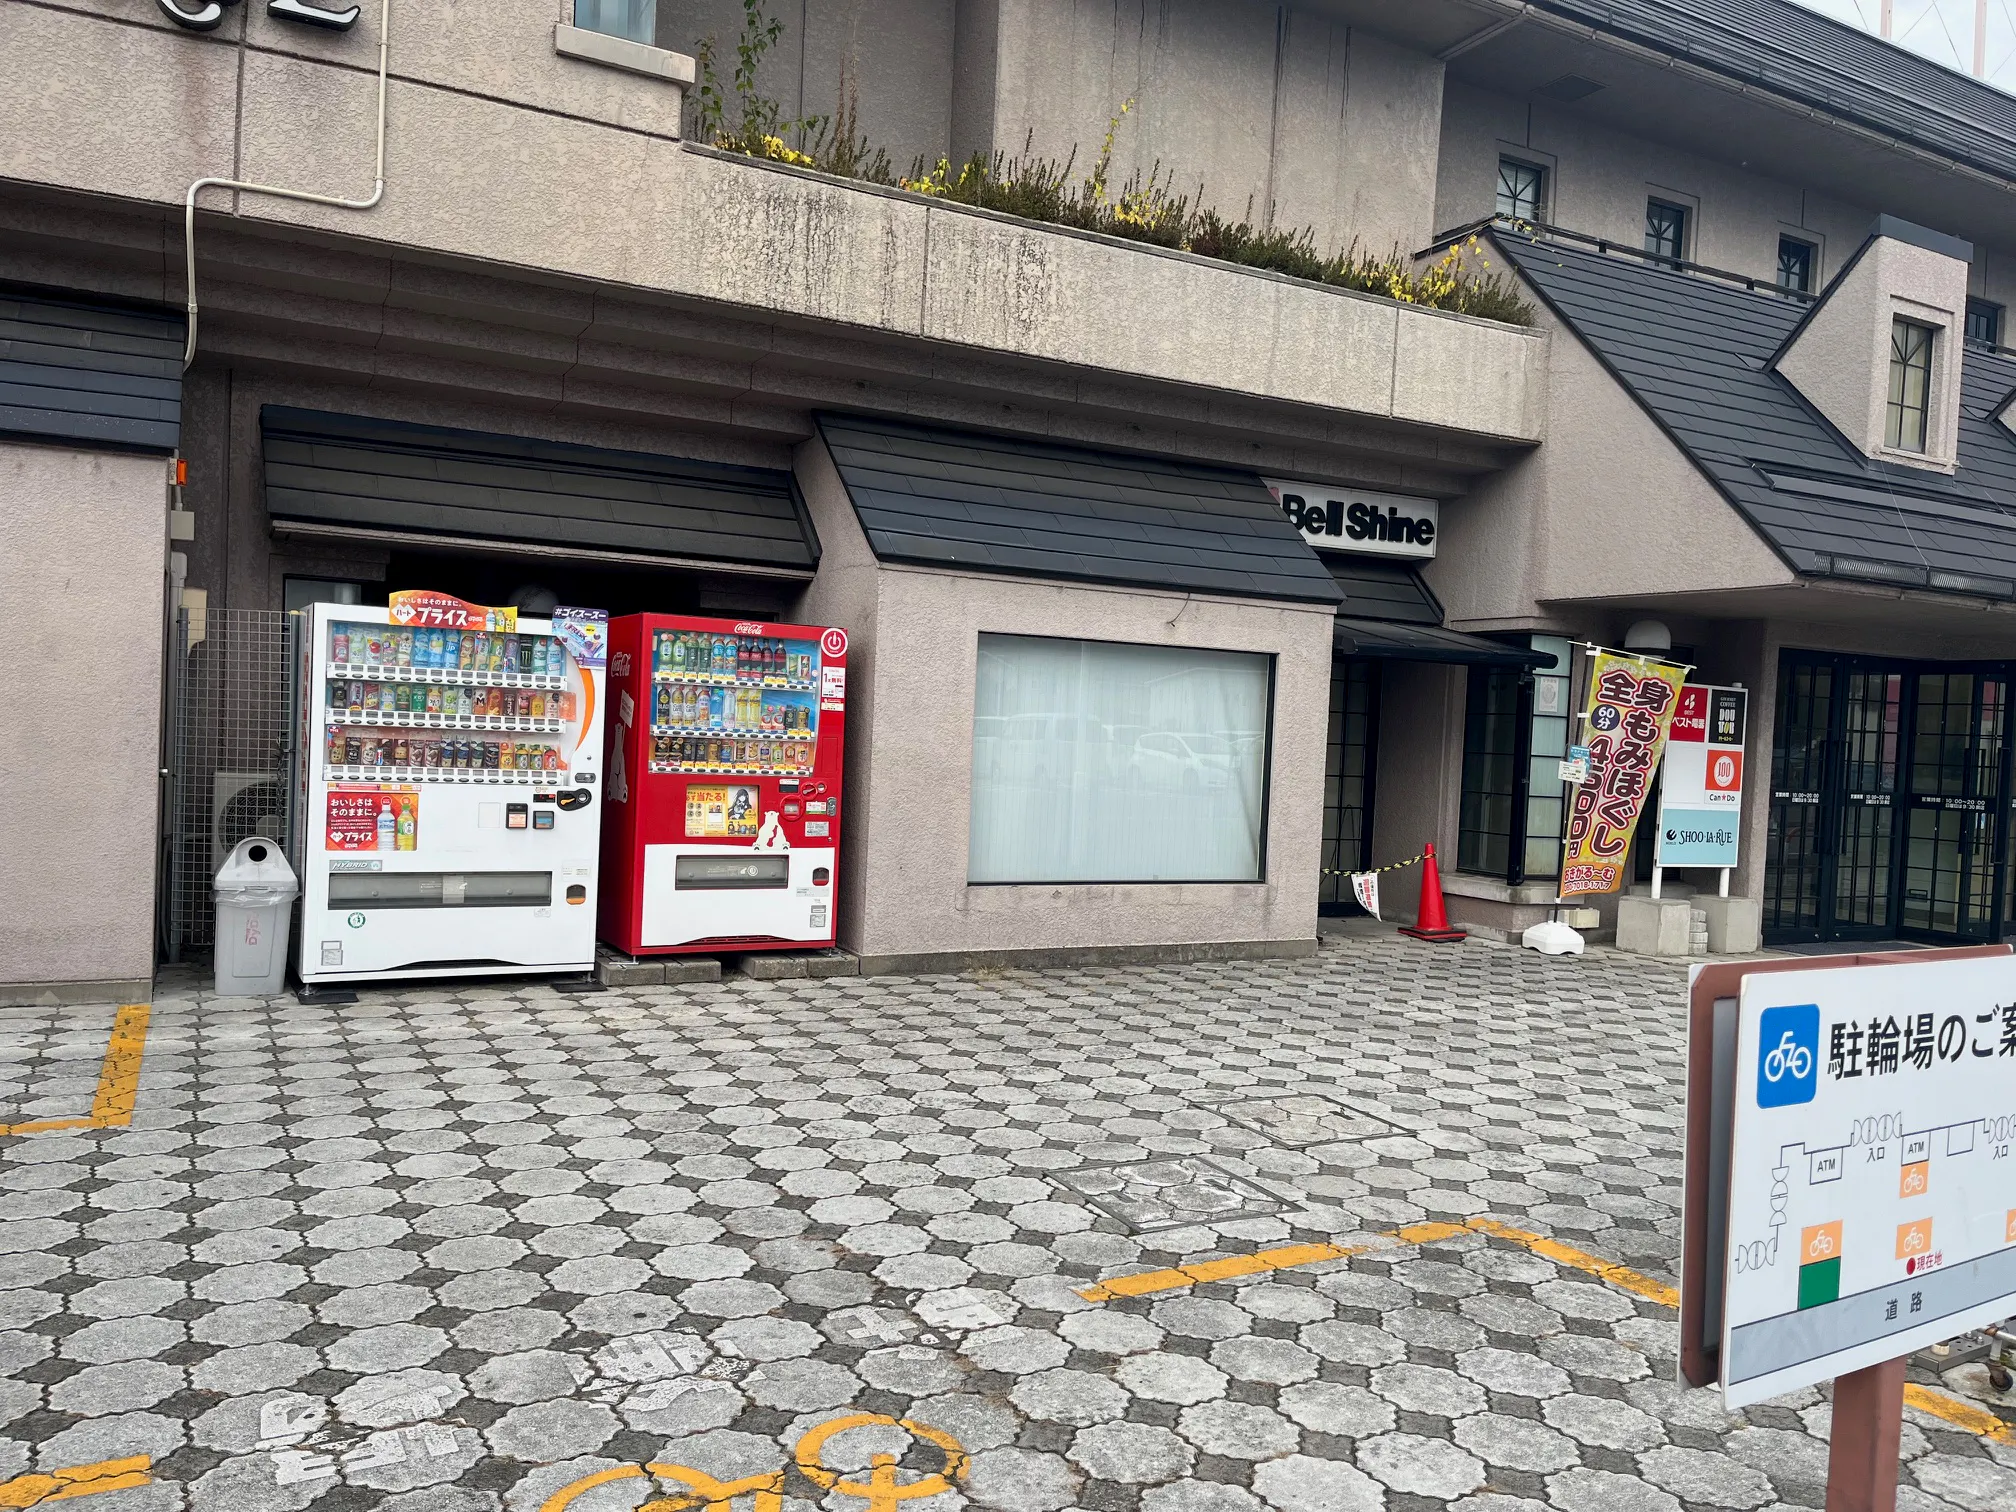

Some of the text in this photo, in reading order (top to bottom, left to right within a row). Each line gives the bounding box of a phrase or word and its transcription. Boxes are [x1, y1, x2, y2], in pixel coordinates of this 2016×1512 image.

[1283, 493, 1434, 546] Bell Shine
[417, 606, 468, 626] プライス
[734, 622, 763, 635] Coca-Cola
[1598, 671, 1674, 714] 全身
[1598, 707, 1615, 718] 60
[1597, 717, 1611, 729] 分
[1717, 762, 1731, 778] 100
[1592, 709, 1659, 856] もみほぐし
[330, 798, 373, 807] おいしさは
[330, 808, 378, 817] そのままに。
[344, 831, 373, 842] プライス
[1866, 1147, 1885, 1163] 入口
[1908, 1141, 1925, 1155] ATM
[1992, 1145, 2009, 1160] 入口
[1817, 1158, 1836, 1173] ATM
[1916, 1250, 1943, 1272] 現在地
